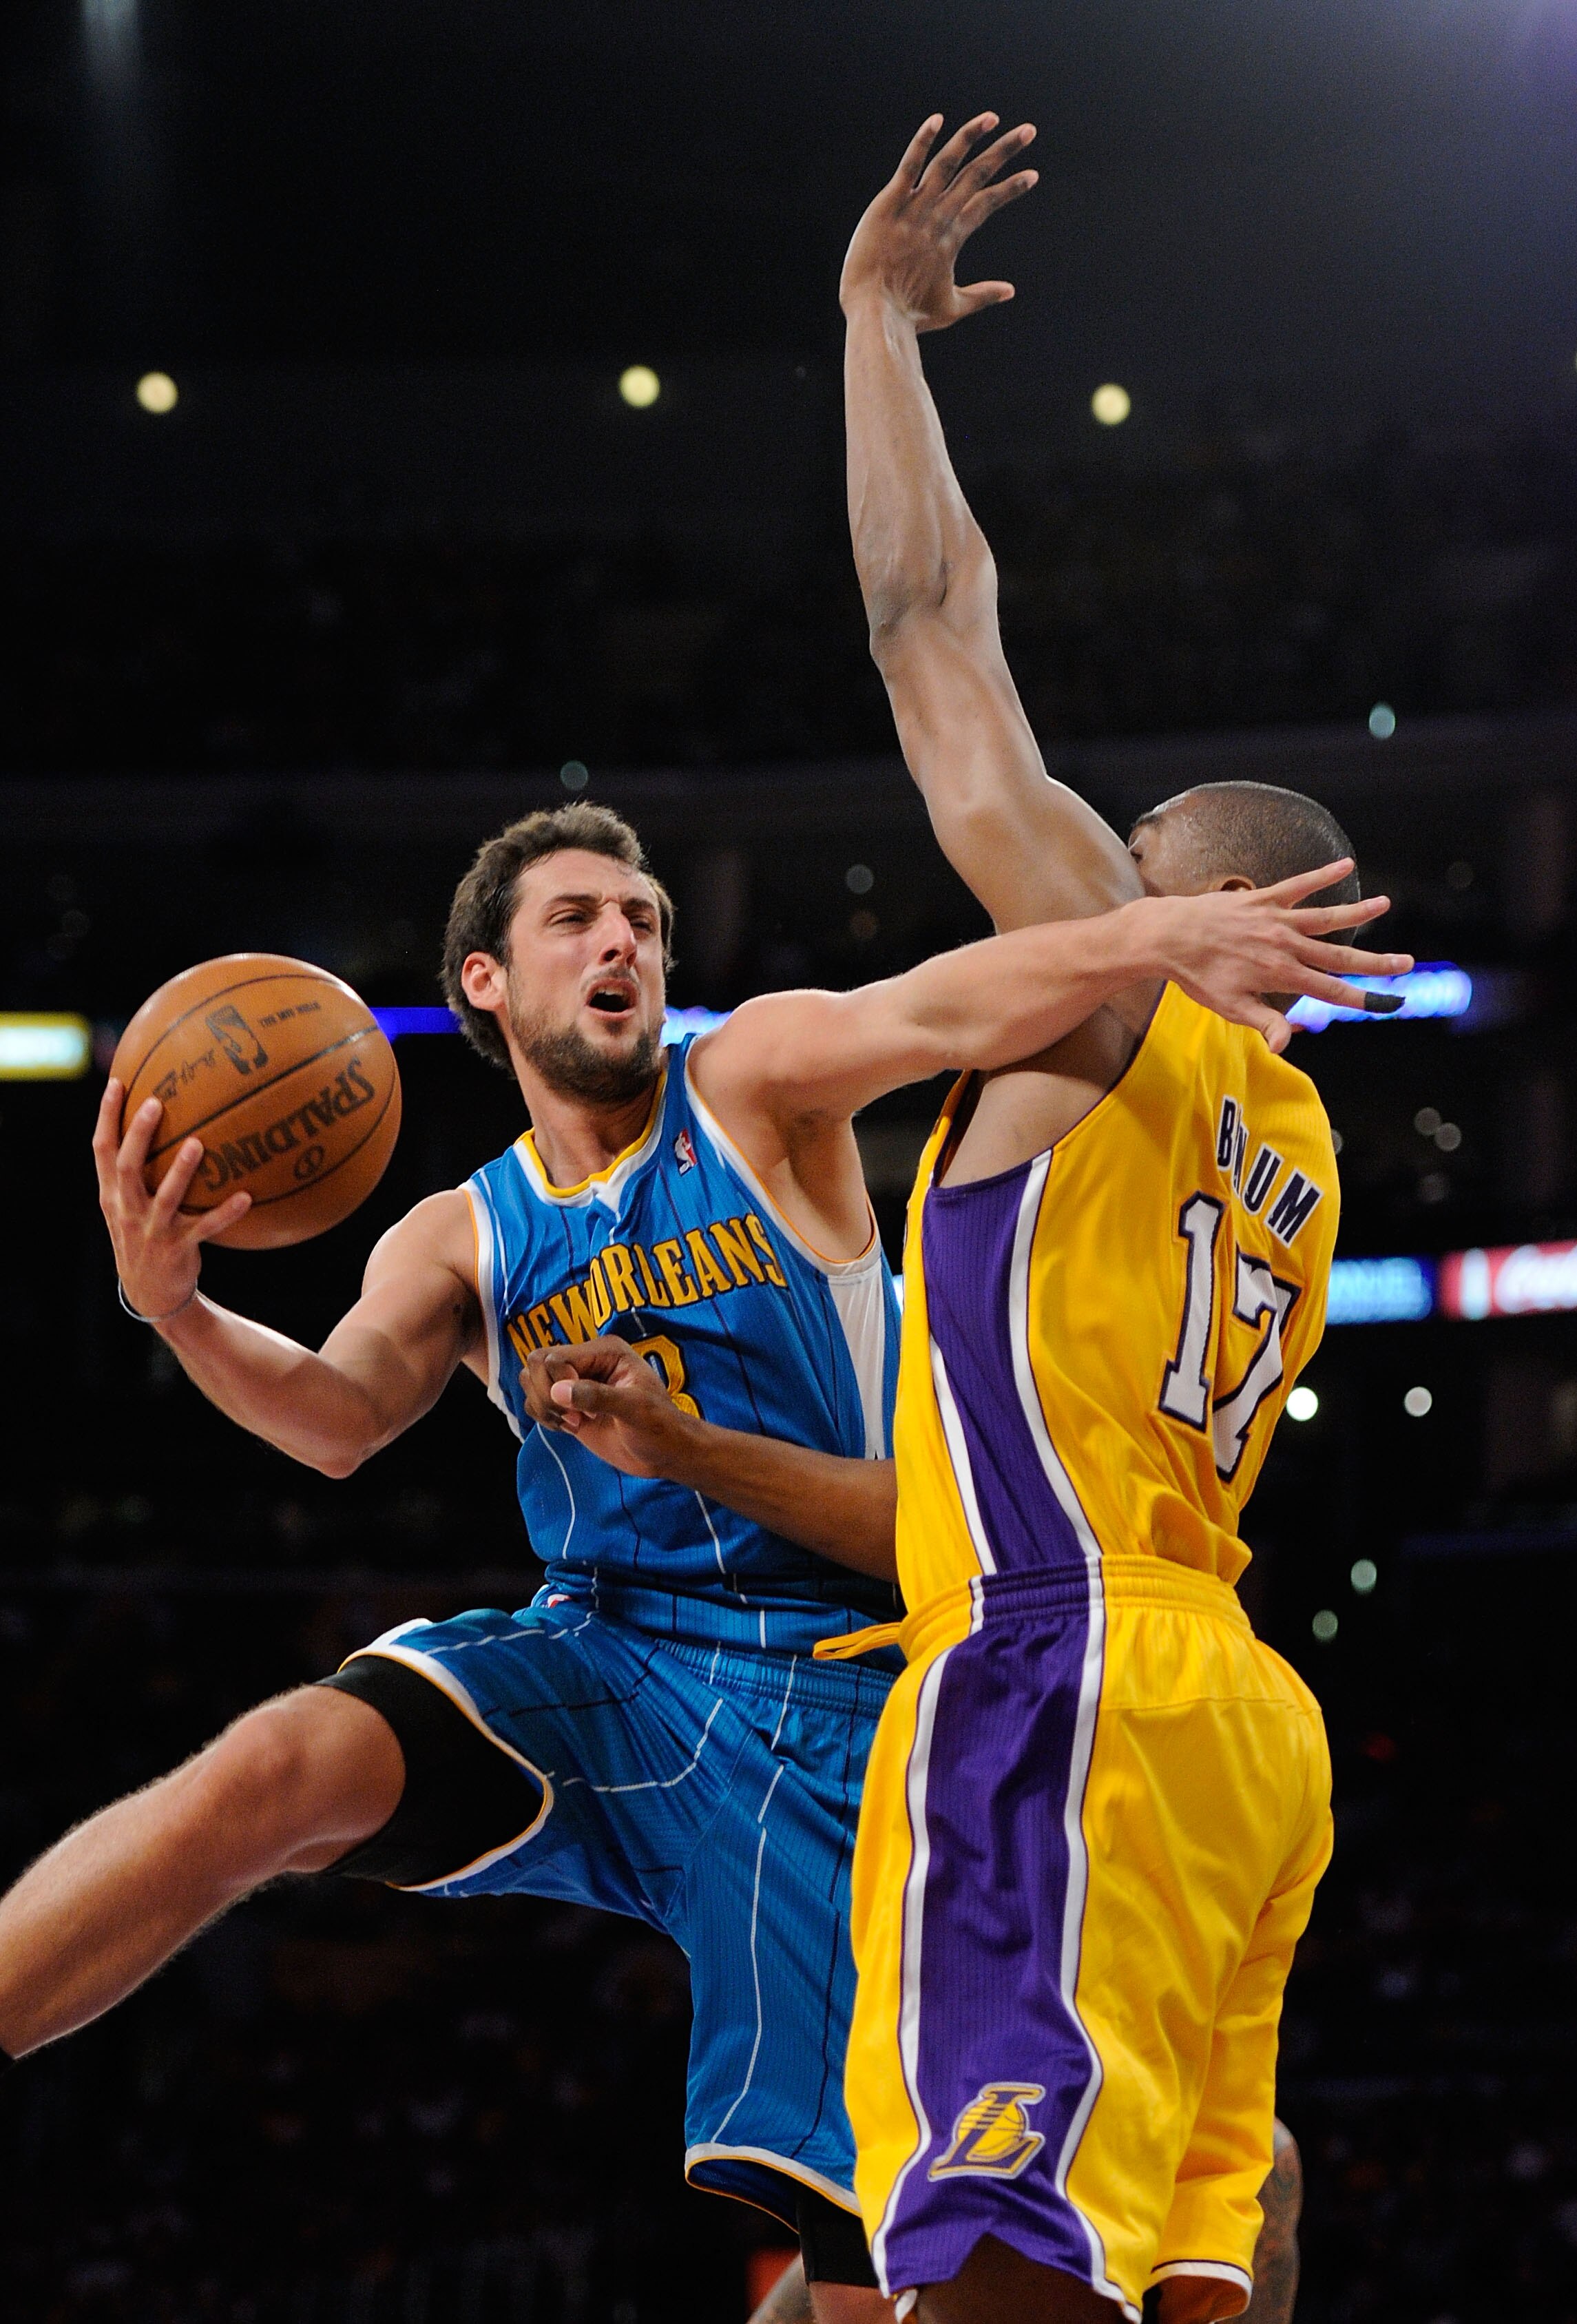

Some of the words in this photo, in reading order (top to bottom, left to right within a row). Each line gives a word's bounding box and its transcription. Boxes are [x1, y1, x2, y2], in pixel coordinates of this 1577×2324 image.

[200, 1055, 375, 1191] SPALDING
[504, 1278, 599, 1368] NEW
[590, 1214, 788, 1329] ORLEANS
[1158, 1190, 1302, 1484] 17
